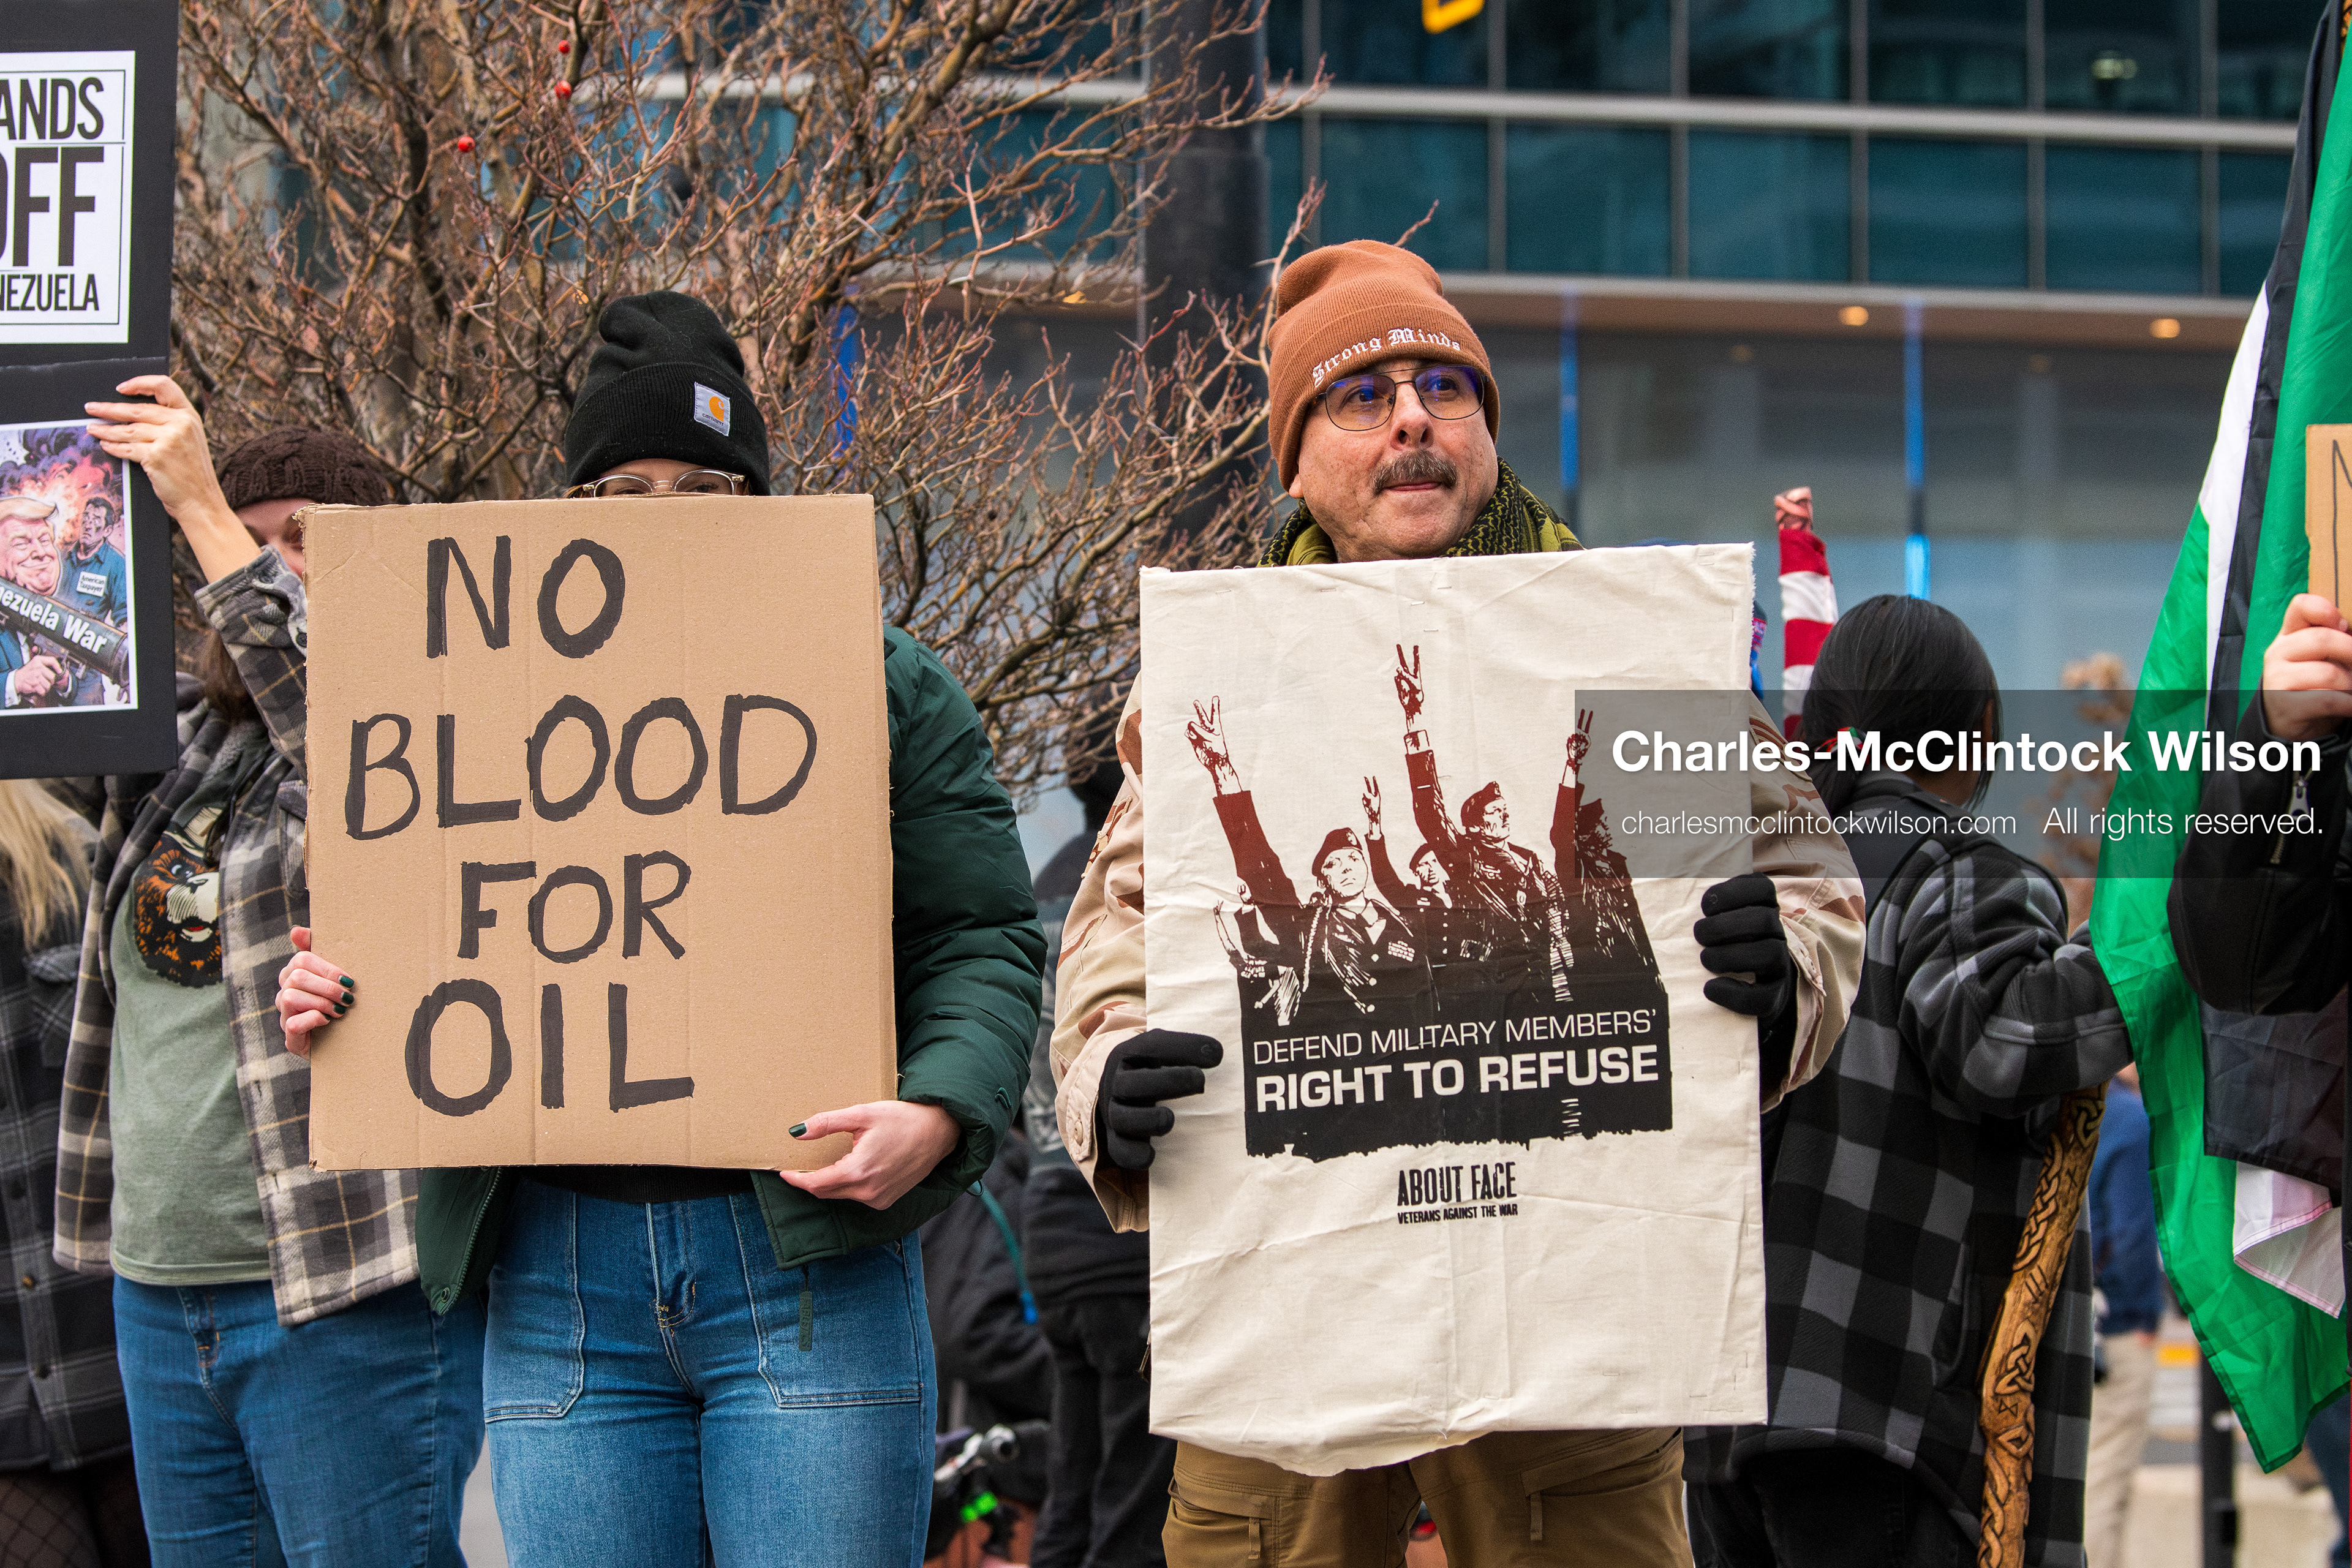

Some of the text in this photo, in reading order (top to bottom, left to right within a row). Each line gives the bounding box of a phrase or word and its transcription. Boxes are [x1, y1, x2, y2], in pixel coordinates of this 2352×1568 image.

[0, 146, 104, 266] FF
[1312, 327, 1461, 388] Strong Minds
[81, 575, 104, 585] American
[427, 535, 625, 659] NO
[63, 614, 108, 654] War
[345, 693, 817, 840] BLOOD
[458, 850, 692, 964] FOR
[405, 978, 695, 1117] OIL
[1254, 1033, 1362, 1065] DEFEND
[1371, 1020, 1496, 1054] MILITARY
[1256, 1044, 1659, 1113] RIGHT TO REFUSE
[1397, 1161, 1517, 1207] ABOUT FACE
[1397, 1203, 1518, 1224] VETERANS AGAINST THE WAR
